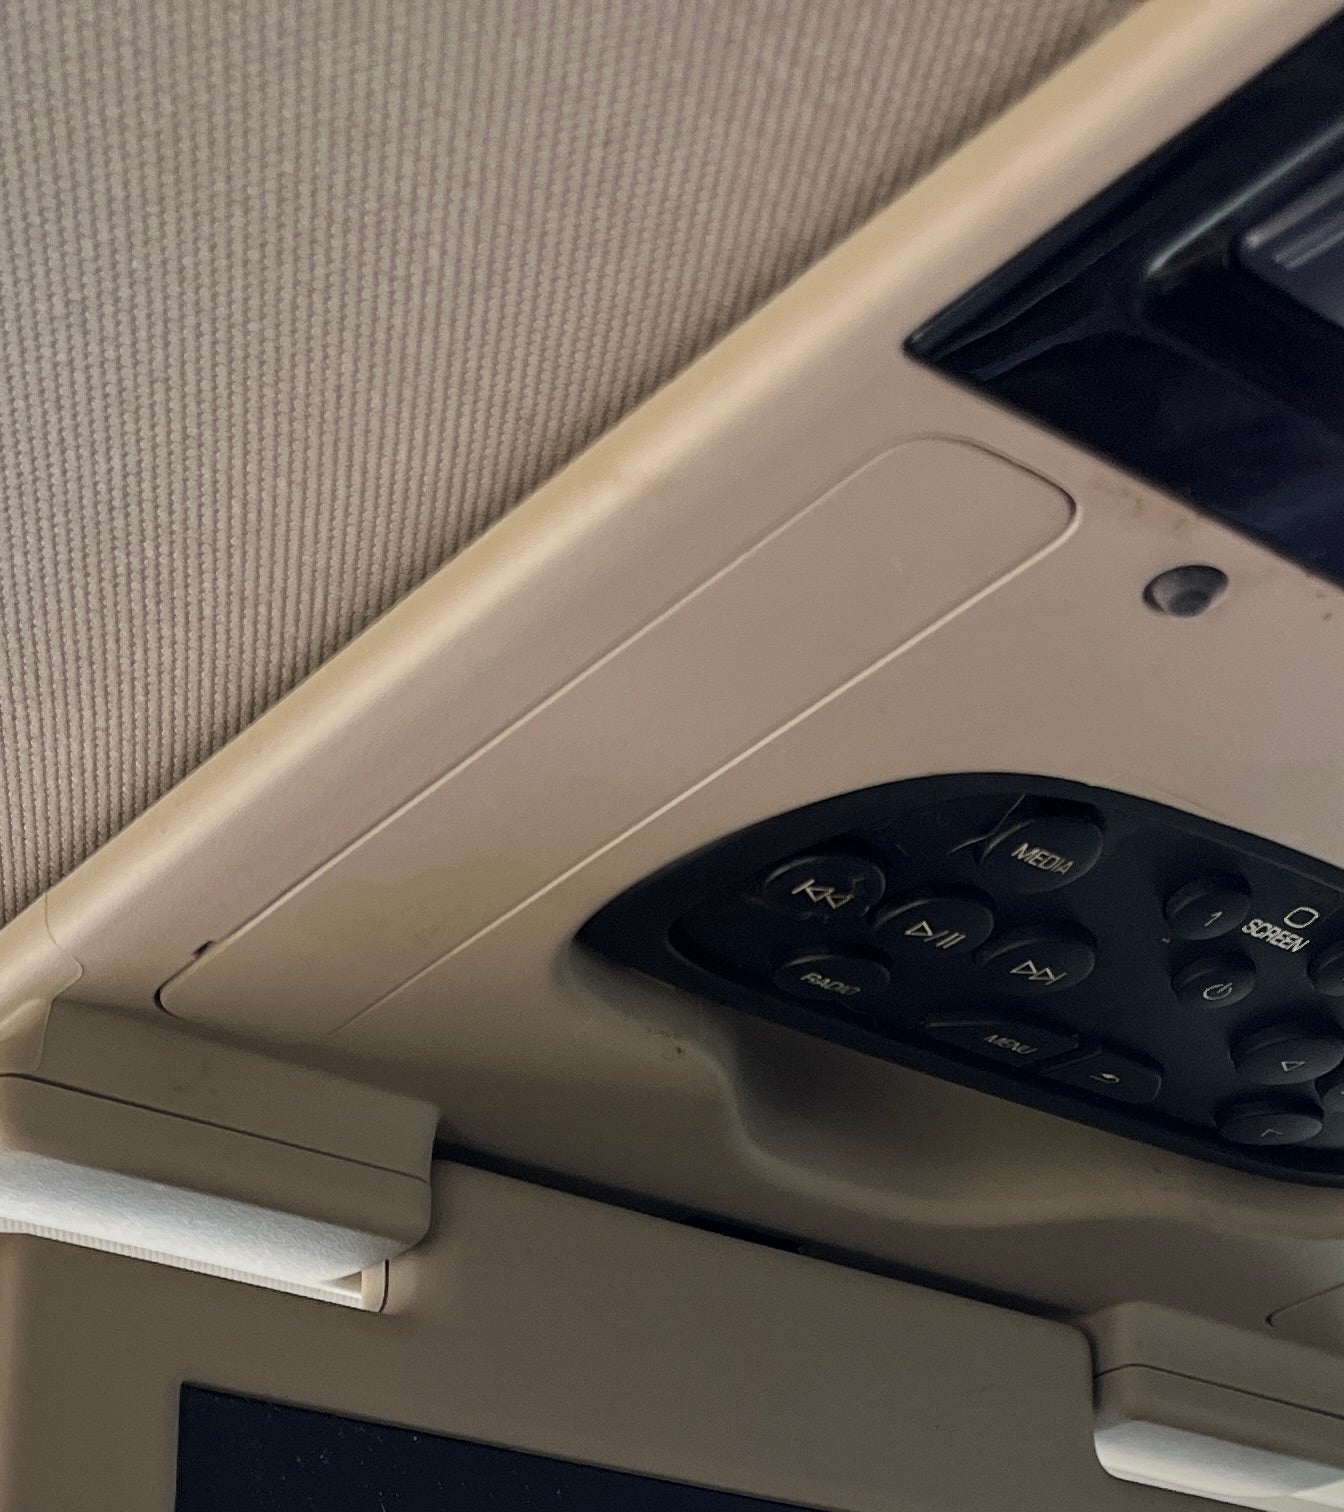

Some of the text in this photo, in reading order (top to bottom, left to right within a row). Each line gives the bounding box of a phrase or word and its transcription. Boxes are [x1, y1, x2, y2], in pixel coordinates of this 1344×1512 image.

[1010, 842, 1075, 875] MEDIA
[1204, 911, 1224, 928] 1
[1242, 918, 1310, 953] SCREEN
[799, 971, 861, 996] RADIO
[983, 1034, 1038, 1055] MENU
